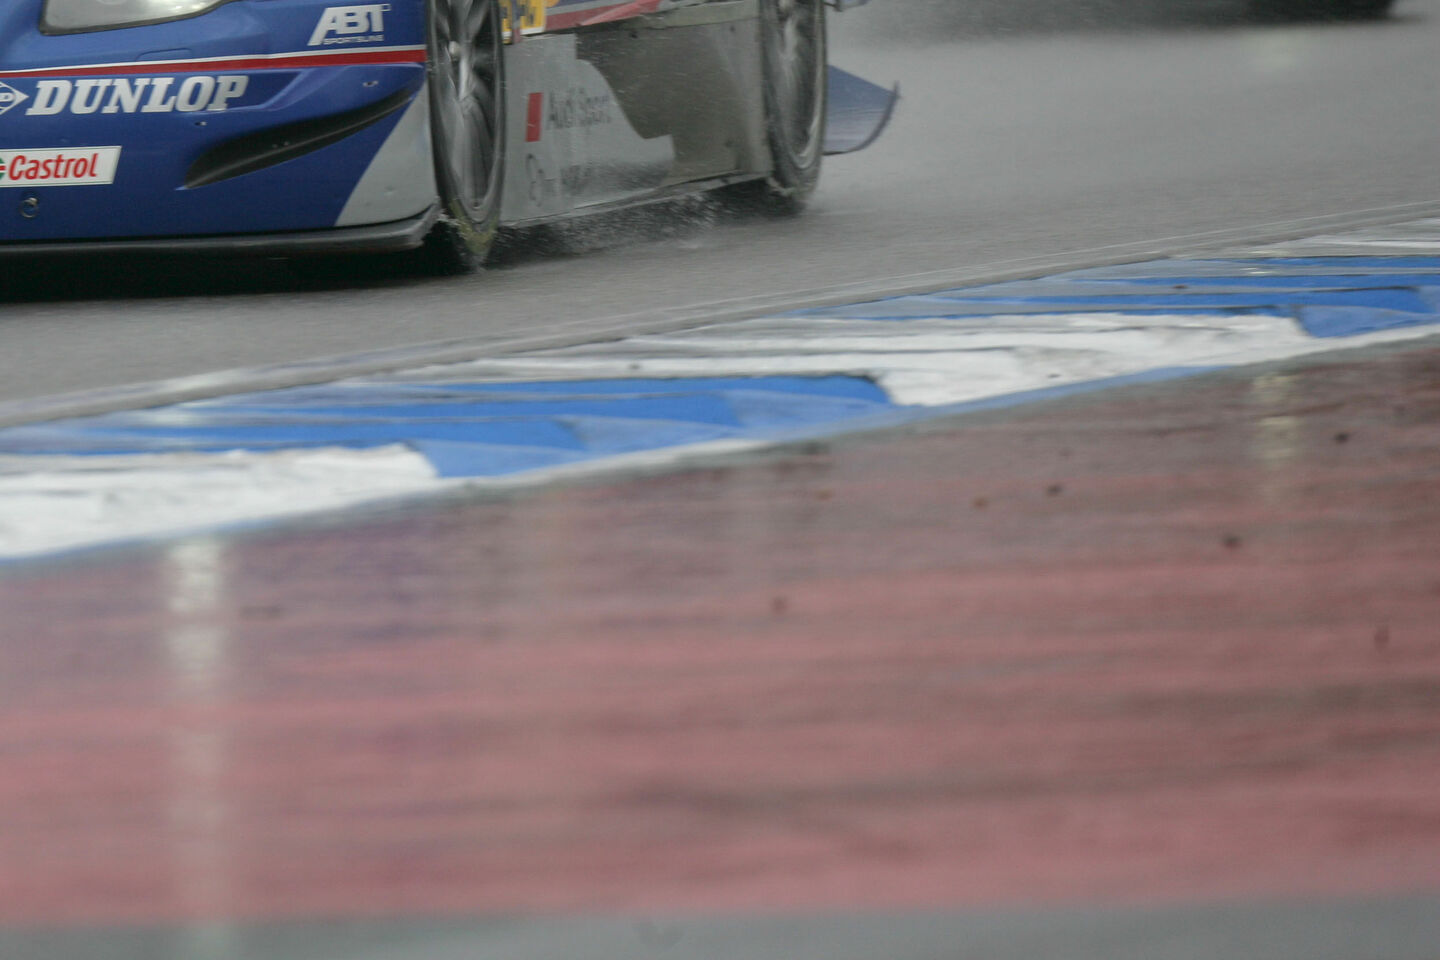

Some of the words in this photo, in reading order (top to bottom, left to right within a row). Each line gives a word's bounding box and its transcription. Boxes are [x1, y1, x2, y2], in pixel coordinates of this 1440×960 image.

[306, 5, 385, 46] ABT
[25, 75, 249, 116] DUNLOP
[8, 152, 98, 182] Castrol
